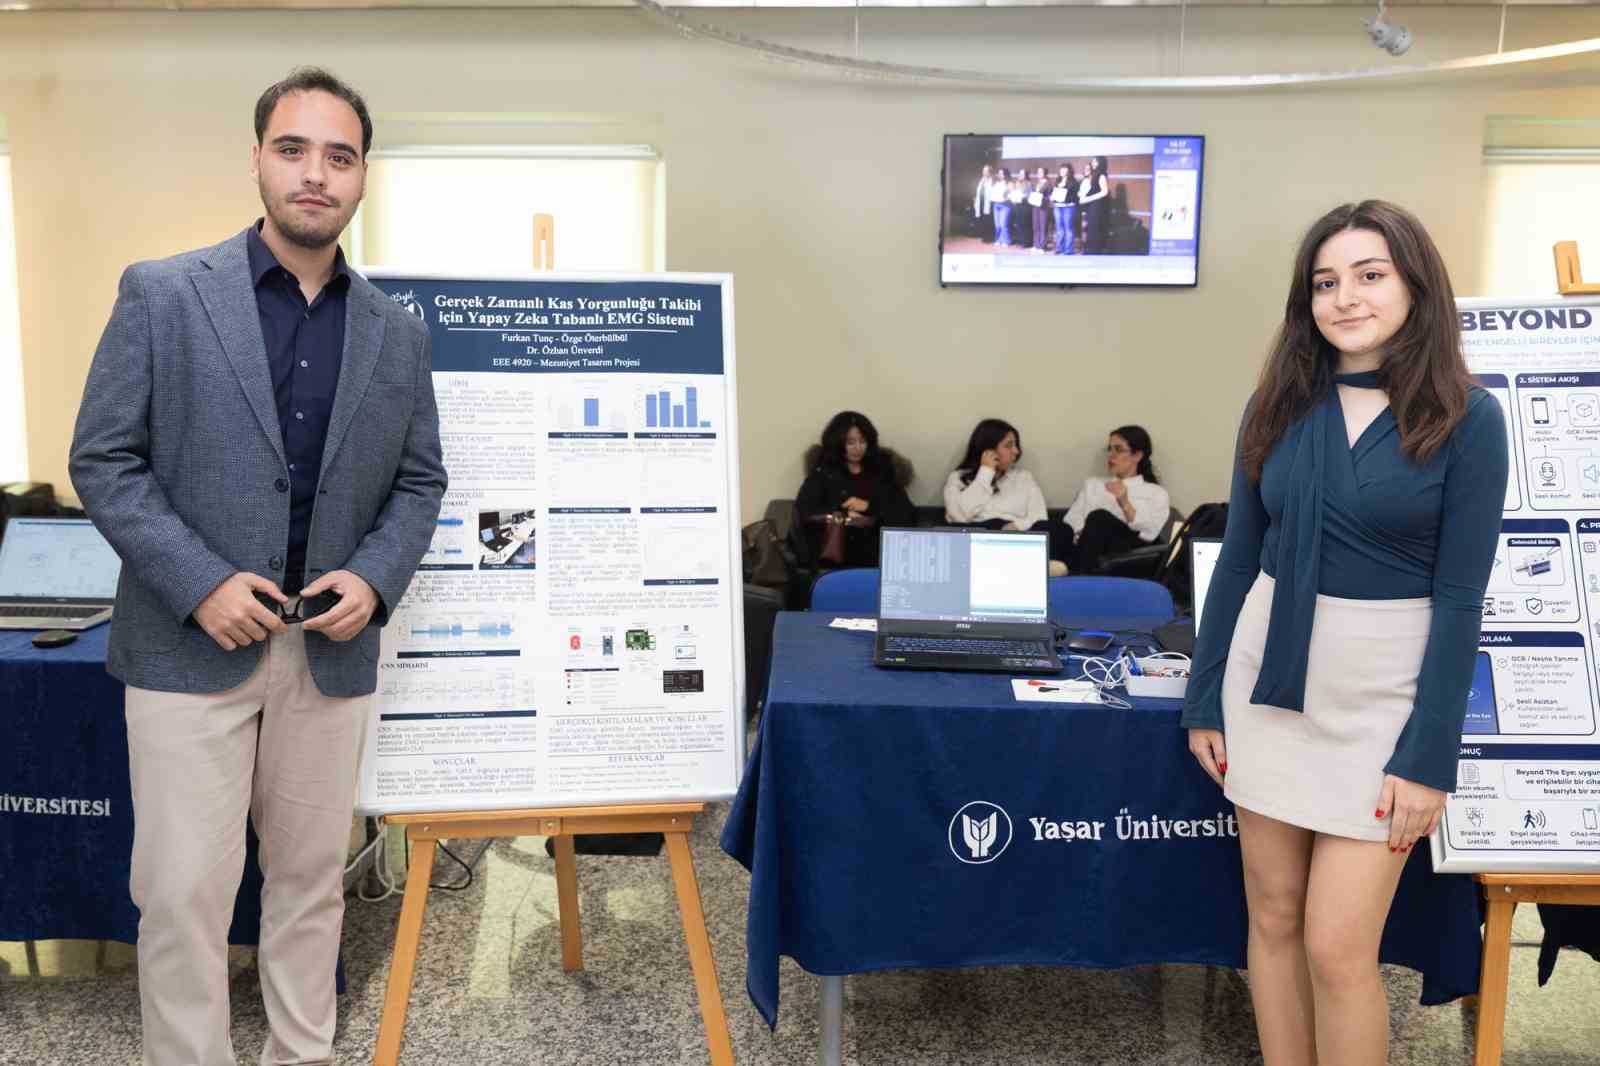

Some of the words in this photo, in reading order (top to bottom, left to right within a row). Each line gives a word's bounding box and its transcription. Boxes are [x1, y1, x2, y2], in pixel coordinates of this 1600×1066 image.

[434, 295, 484, 310] Gerçek
[487, 296, 544, 309] Zamanlı
[547, 297, 573, 310] Kas
[577, 297, 656, 312] Yorgunluğu
[658, 297, 702, 311] Takibi
[439, 311, 464, 326] için
[468, 311, 511, 327] Yapay
[514, 312, 549, 325] Zeka
[552, 313, 603, 326] Tabanlı
[607, 312, 643, 325] EMG
[647, 313, 695, 327] Sistemi
[1458, 308, 1593, 331] BEYOND
[501, 333, 531, 343] Furkan
[533, 334, 553, 345] Tunç
[561, 332, 582, 345] Özge
[527, 346, 539, 355] Dr.
[493, 358, 511, 367] EEE
[614, 358, 641, 368] Projesi
[0, 794, 111, 816] İVERSİTESİ
[1029, 816, 1105, 842] Yaşar
[1115, 808, 1239, 840] Üniversit
